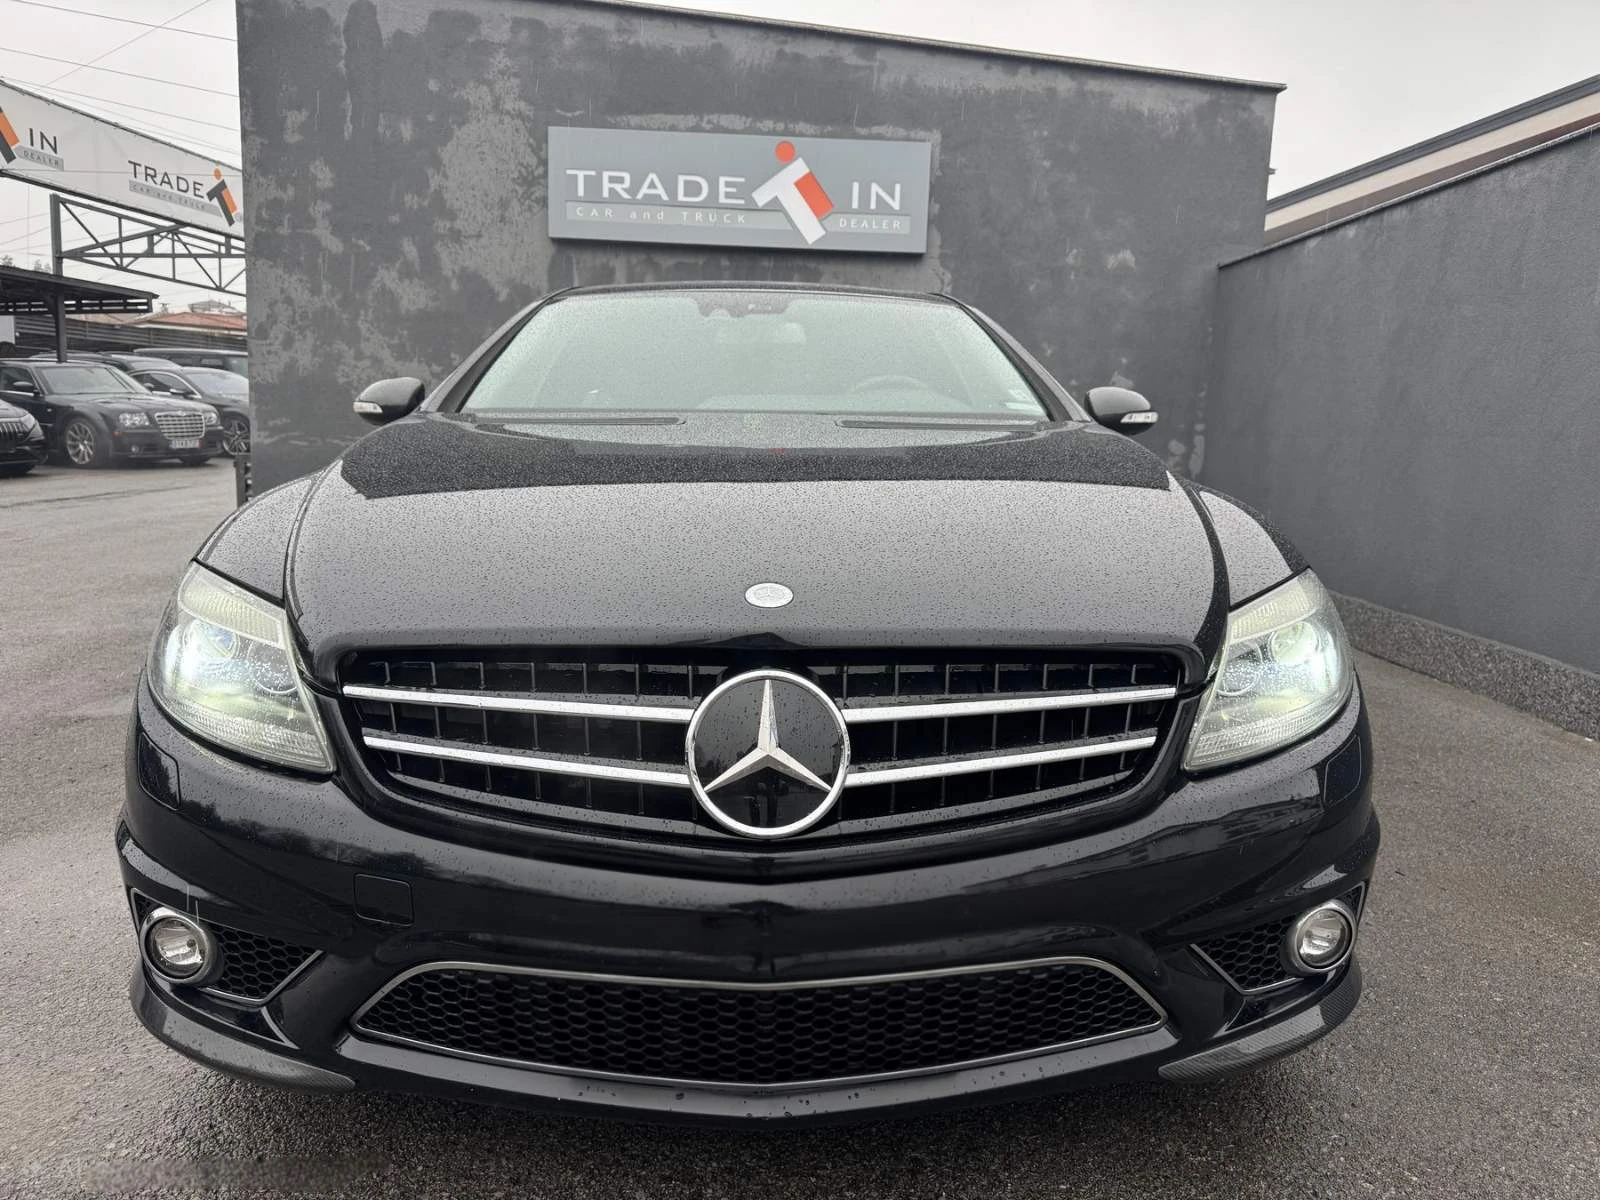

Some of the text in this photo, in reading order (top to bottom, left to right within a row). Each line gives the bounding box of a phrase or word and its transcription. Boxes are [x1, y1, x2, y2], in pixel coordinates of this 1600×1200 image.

[29, 128, 58, 155] IN
[128, 160, 205, 199] TRADE
[565, 169, 746, 205] TRADE
[851, 181, 901, 211] IN
[575, 206, 902, 230] CAR and TRUCK DEALER
